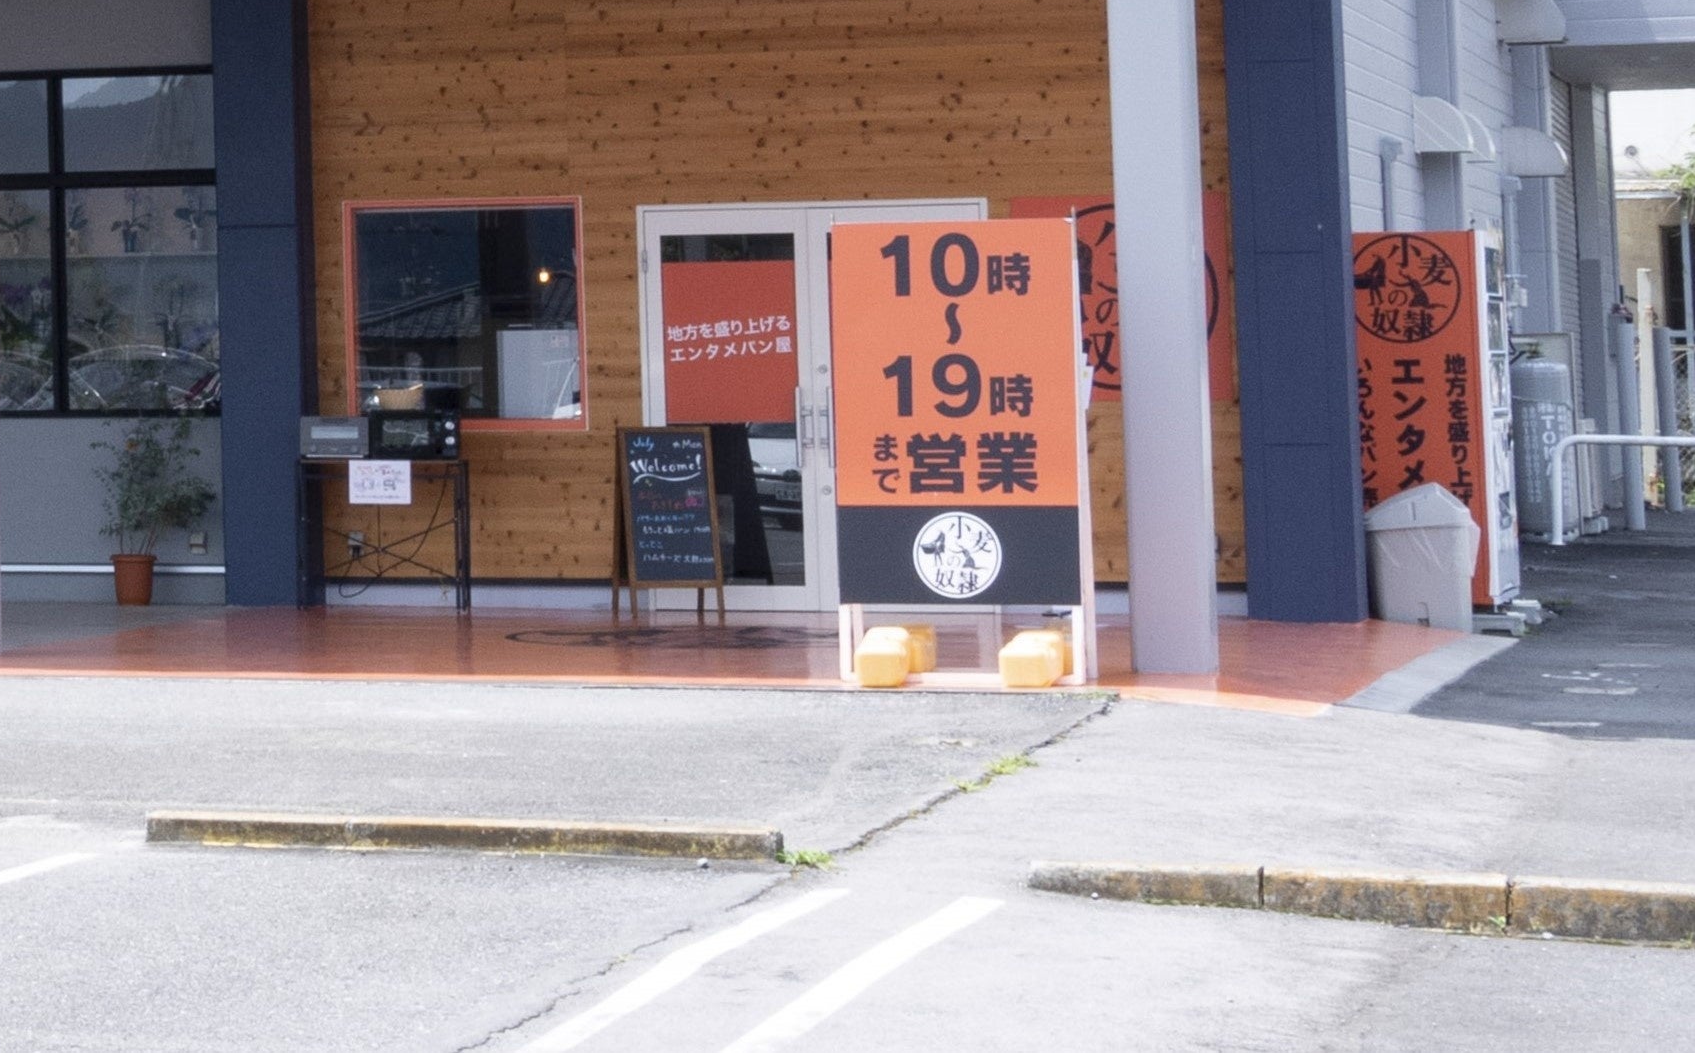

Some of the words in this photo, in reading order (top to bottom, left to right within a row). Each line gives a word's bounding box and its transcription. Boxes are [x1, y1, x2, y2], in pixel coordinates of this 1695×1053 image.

[880, 232, 1031, 297] 10時
[667, 315, 791, 342] 地方を盛り上げる
[670, 336, 793, 362] エンタメパン屋
[882, 353, 1034, 418] 19時
[630, 453, 702, 474] Welcome!
[906, 431, 1038, 494] 営業
